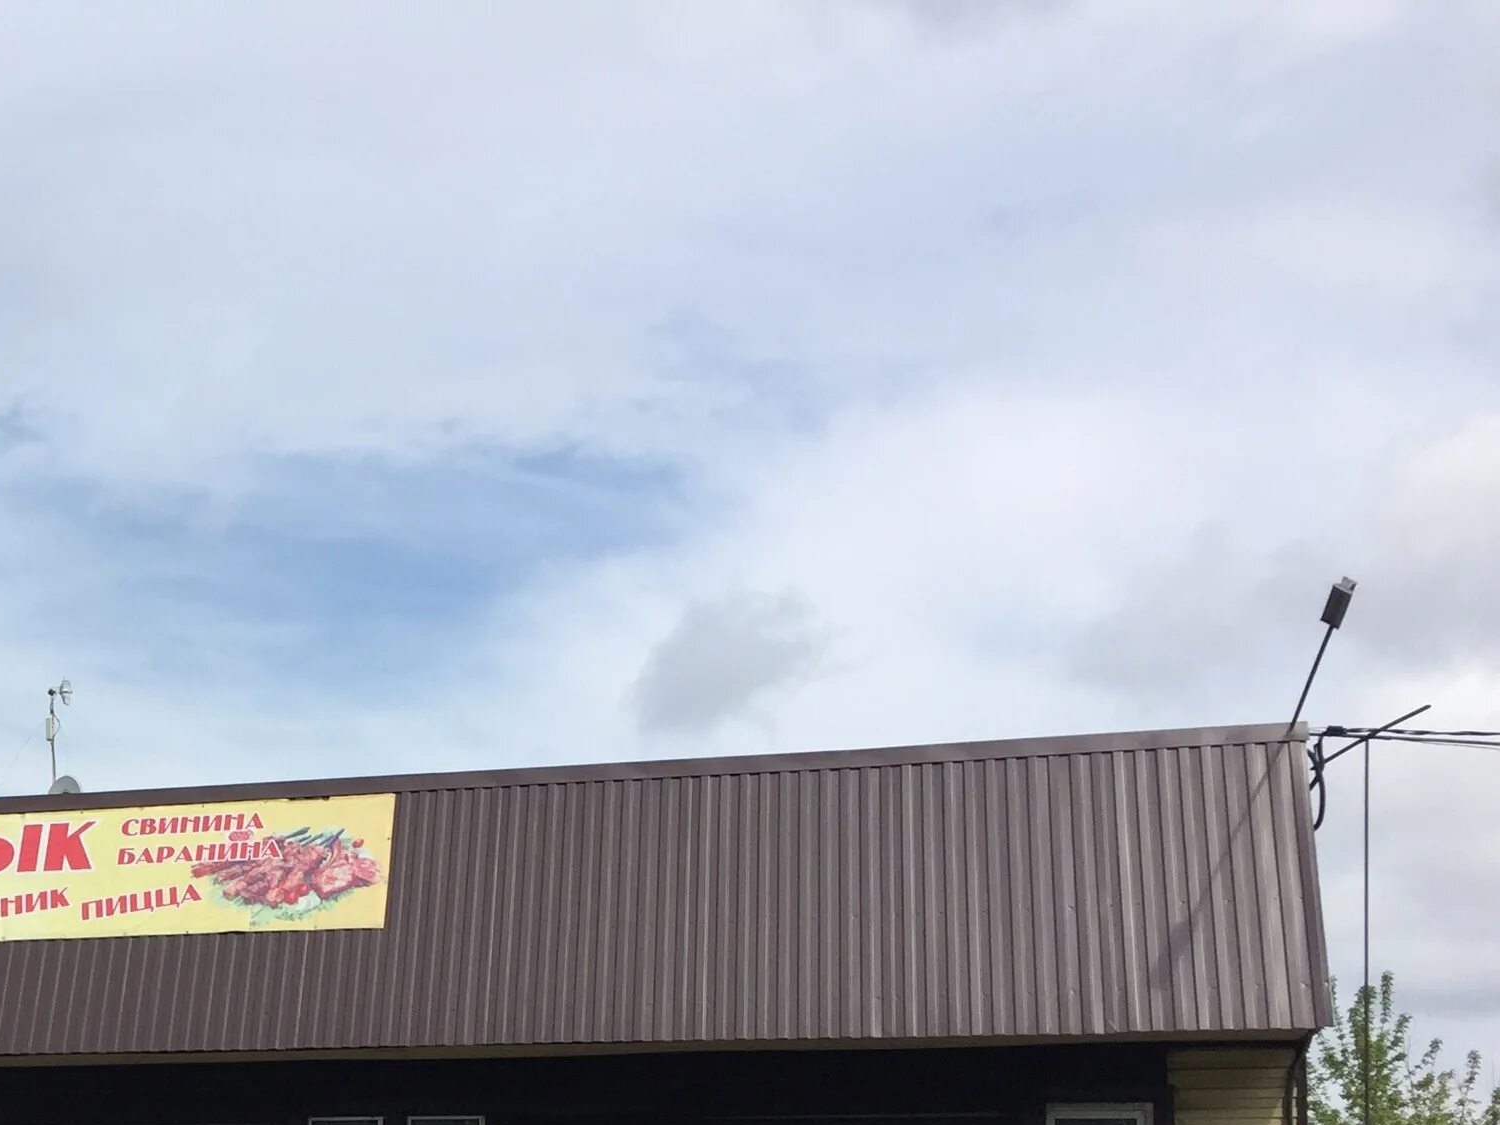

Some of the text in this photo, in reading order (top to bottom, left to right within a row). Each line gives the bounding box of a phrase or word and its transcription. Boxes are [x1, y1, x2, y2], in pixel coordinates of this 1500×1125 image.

[121, 813, 264, 836] СВИНИНА
[116, 839, 282, 865] БАРАНИНА
[81, 883, 203, 921] ПИЦЦА
